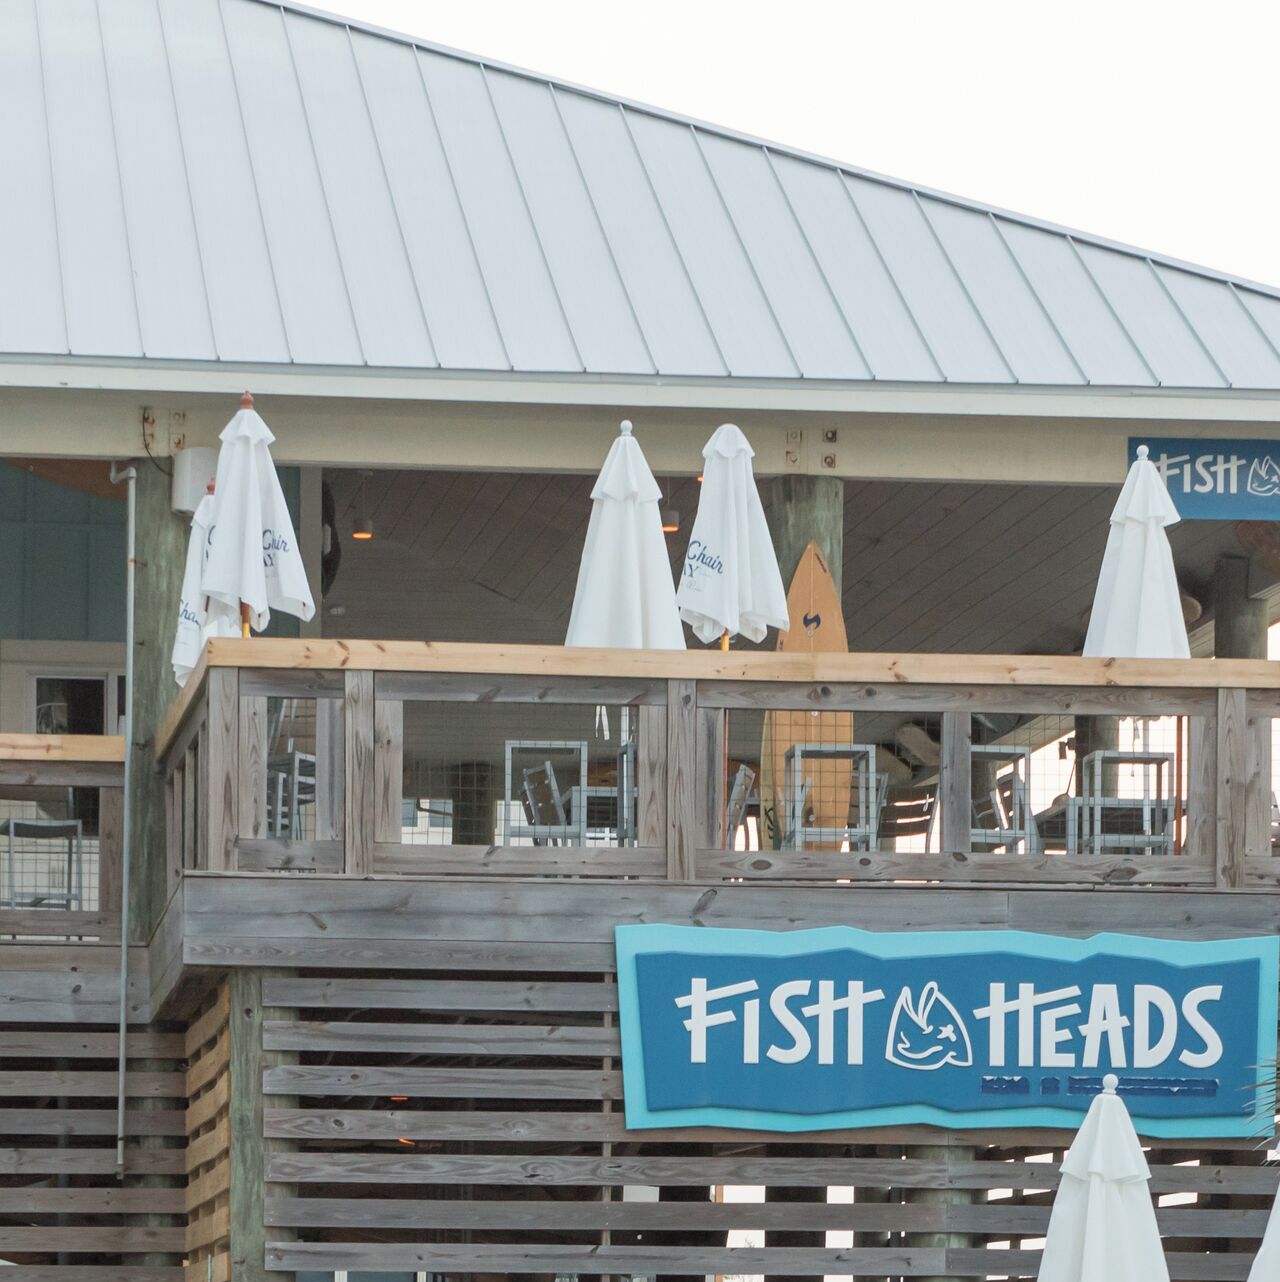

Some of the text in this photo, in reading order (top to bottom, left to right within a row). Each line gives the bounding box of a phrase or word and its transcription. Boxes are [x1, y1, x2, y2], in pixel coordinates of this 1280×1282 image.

[1155, 453, 1246, 494] FISH
[687, 540, 724, 574] Chair
[674, 977, 1223, 1069] FISH HEADS
